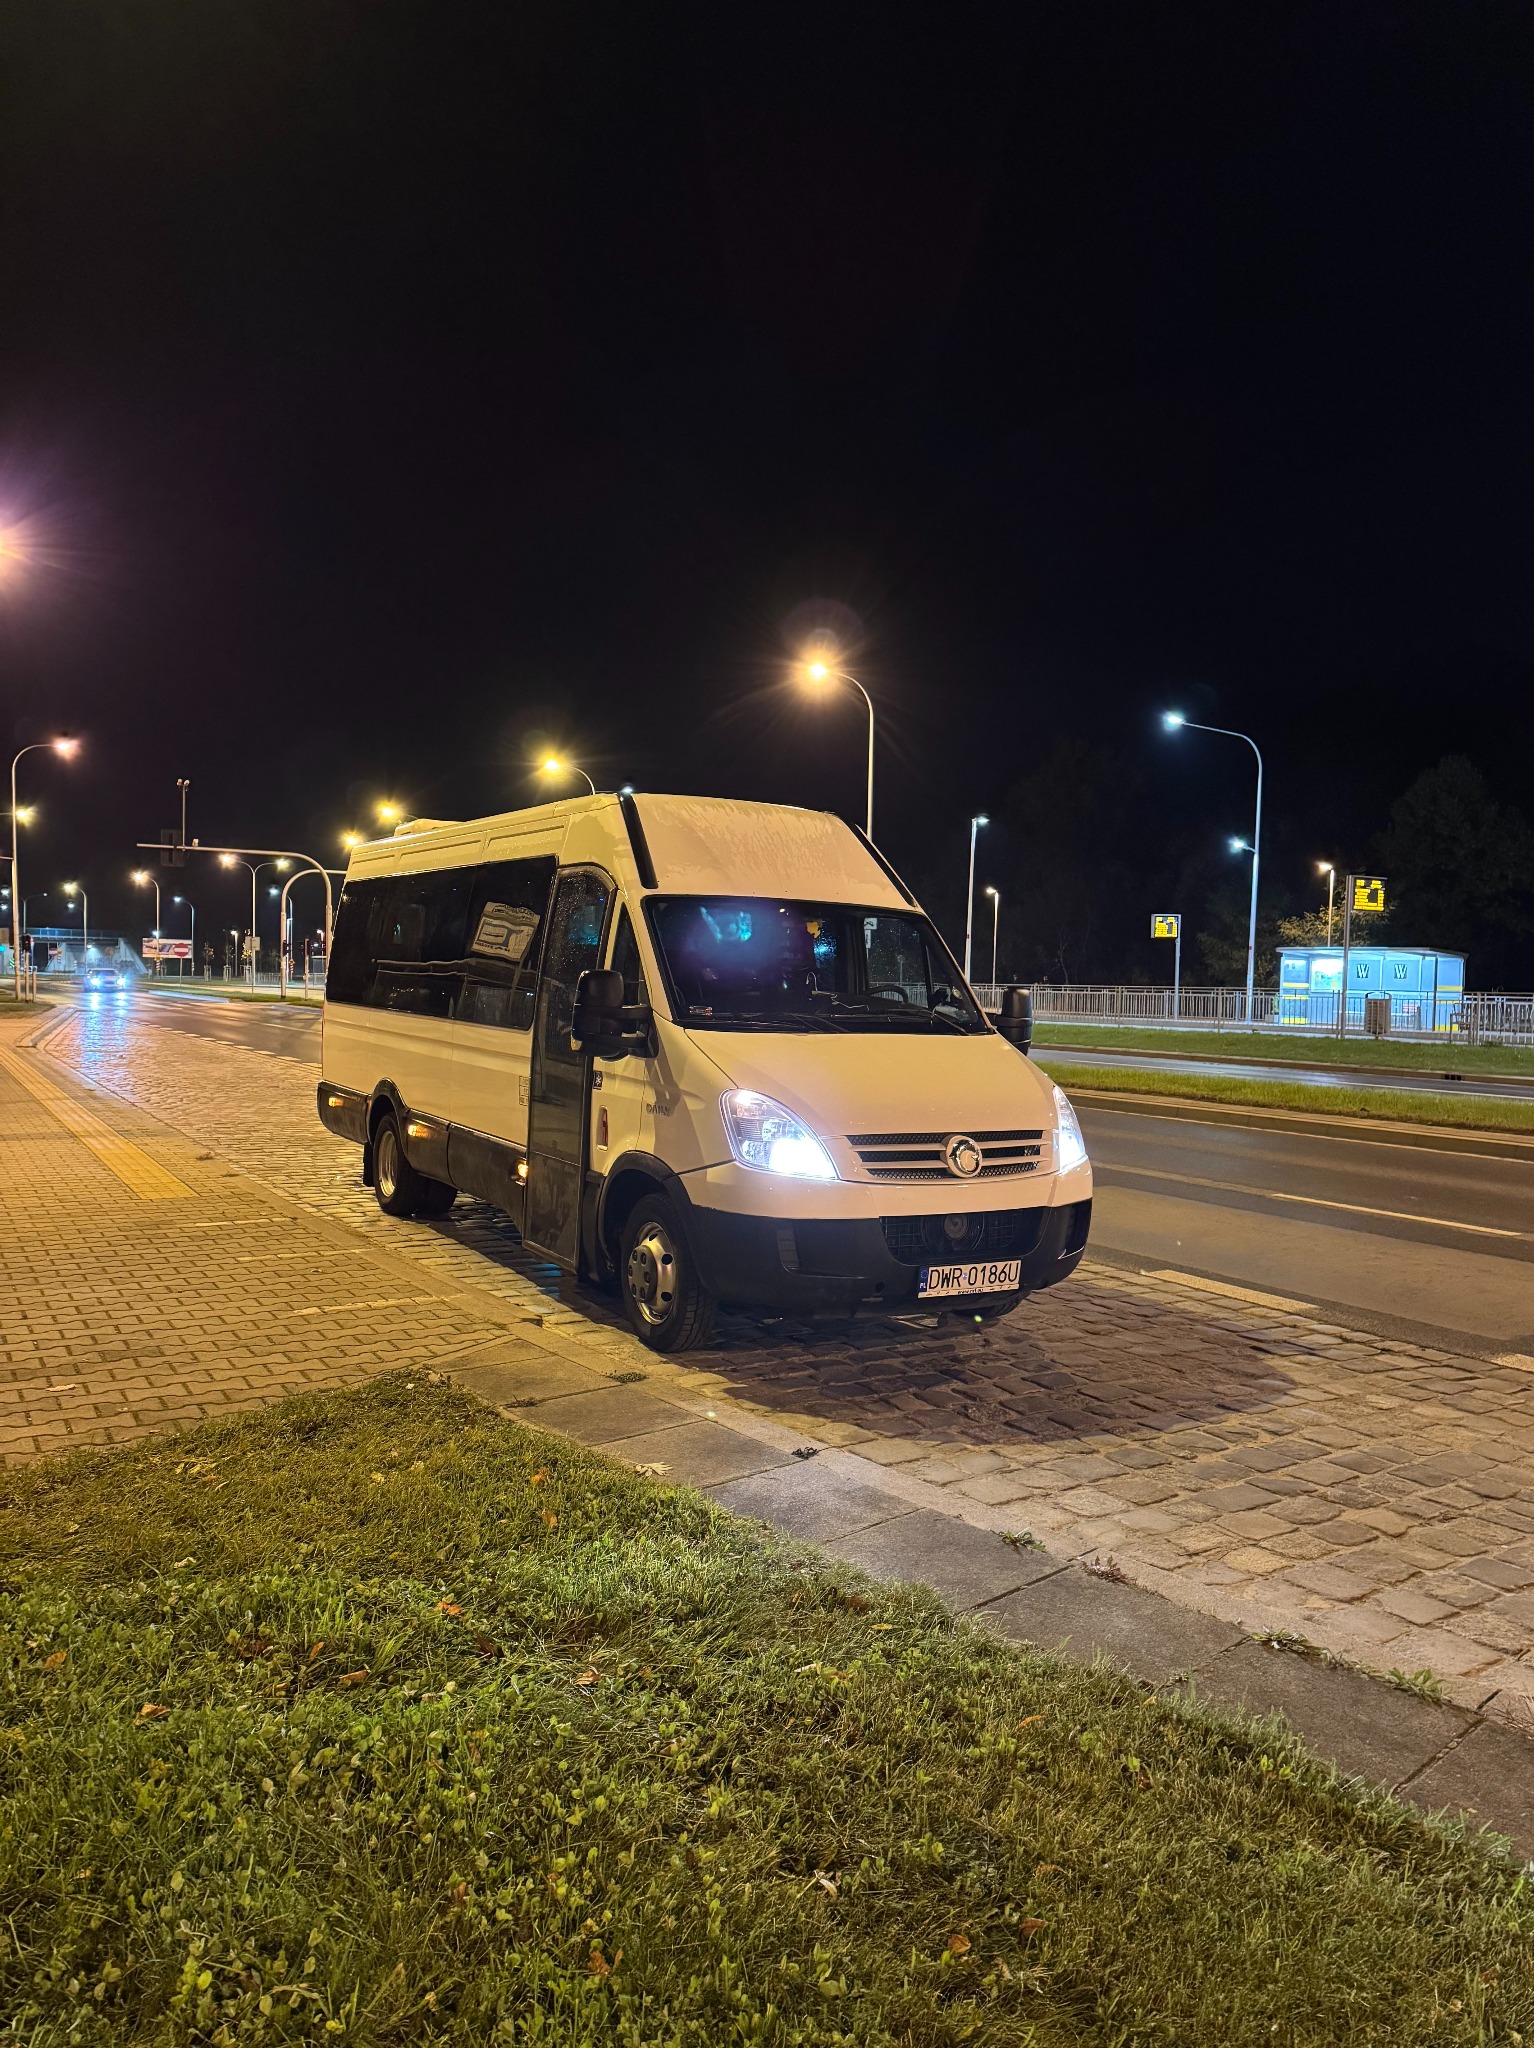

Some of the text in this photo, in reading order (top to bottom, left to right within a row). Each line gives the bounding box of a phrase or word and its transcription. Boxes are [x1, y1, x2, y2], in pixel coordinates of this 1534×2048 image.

[1357, 964, 1369, 978] W
[1394, 964, 1407, 978] W
[928, 1262, 1019, 1290] DWR 0186U
